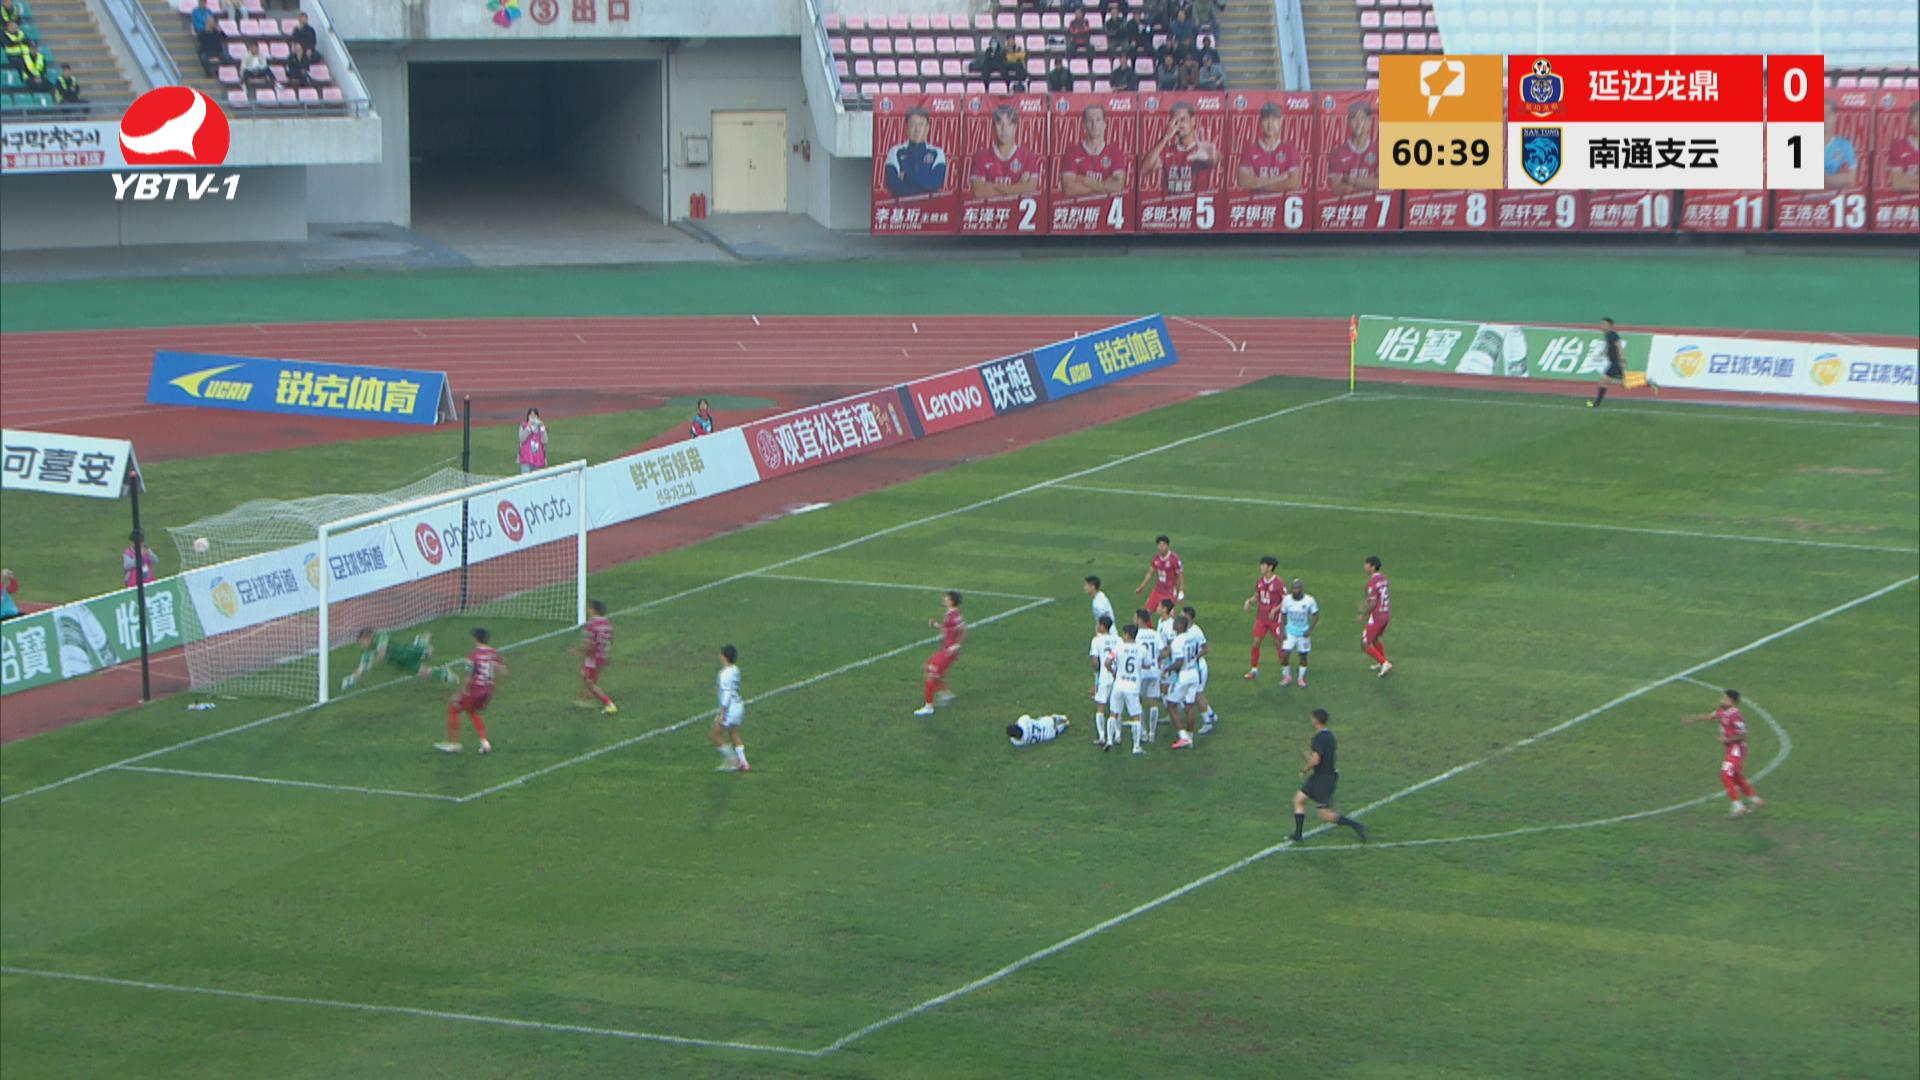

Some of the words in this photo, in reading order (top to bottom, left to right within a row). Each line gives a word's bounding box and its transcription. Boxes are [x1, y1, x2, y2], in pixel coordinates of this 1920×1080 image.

[1018, 198, 1038, 231] 2
[1106, 197, 1125, 230] 4
[1196, 196, 1215, 230] 5
[1284, 196, 1304, 230] 6
[1375, 195, 1392, 229] 7
[1466, 193, 1487, 227] 8
[1555, 194, 1576, 228] 9
[1638, 193, 1670, 228] 10
[1733, 196, 1763, 229] 11
[1830, 194, 1867, 229] 13
[1094, 327, 1166, 375] 锐克体育
[982, 358, 1037, 410] 联想
[1847, 361, 1920, 387] 足球频
[275, 369, 420, 415] 锐克体育
[917, 383, 983, 422] Lenovo
[772, 402, 883, 467] 观茸松茸酒
[3, 444, 116, 487] 可喜安
[523, 495, 572, 534] photo
[1124, 655, 1136, 675] 6
